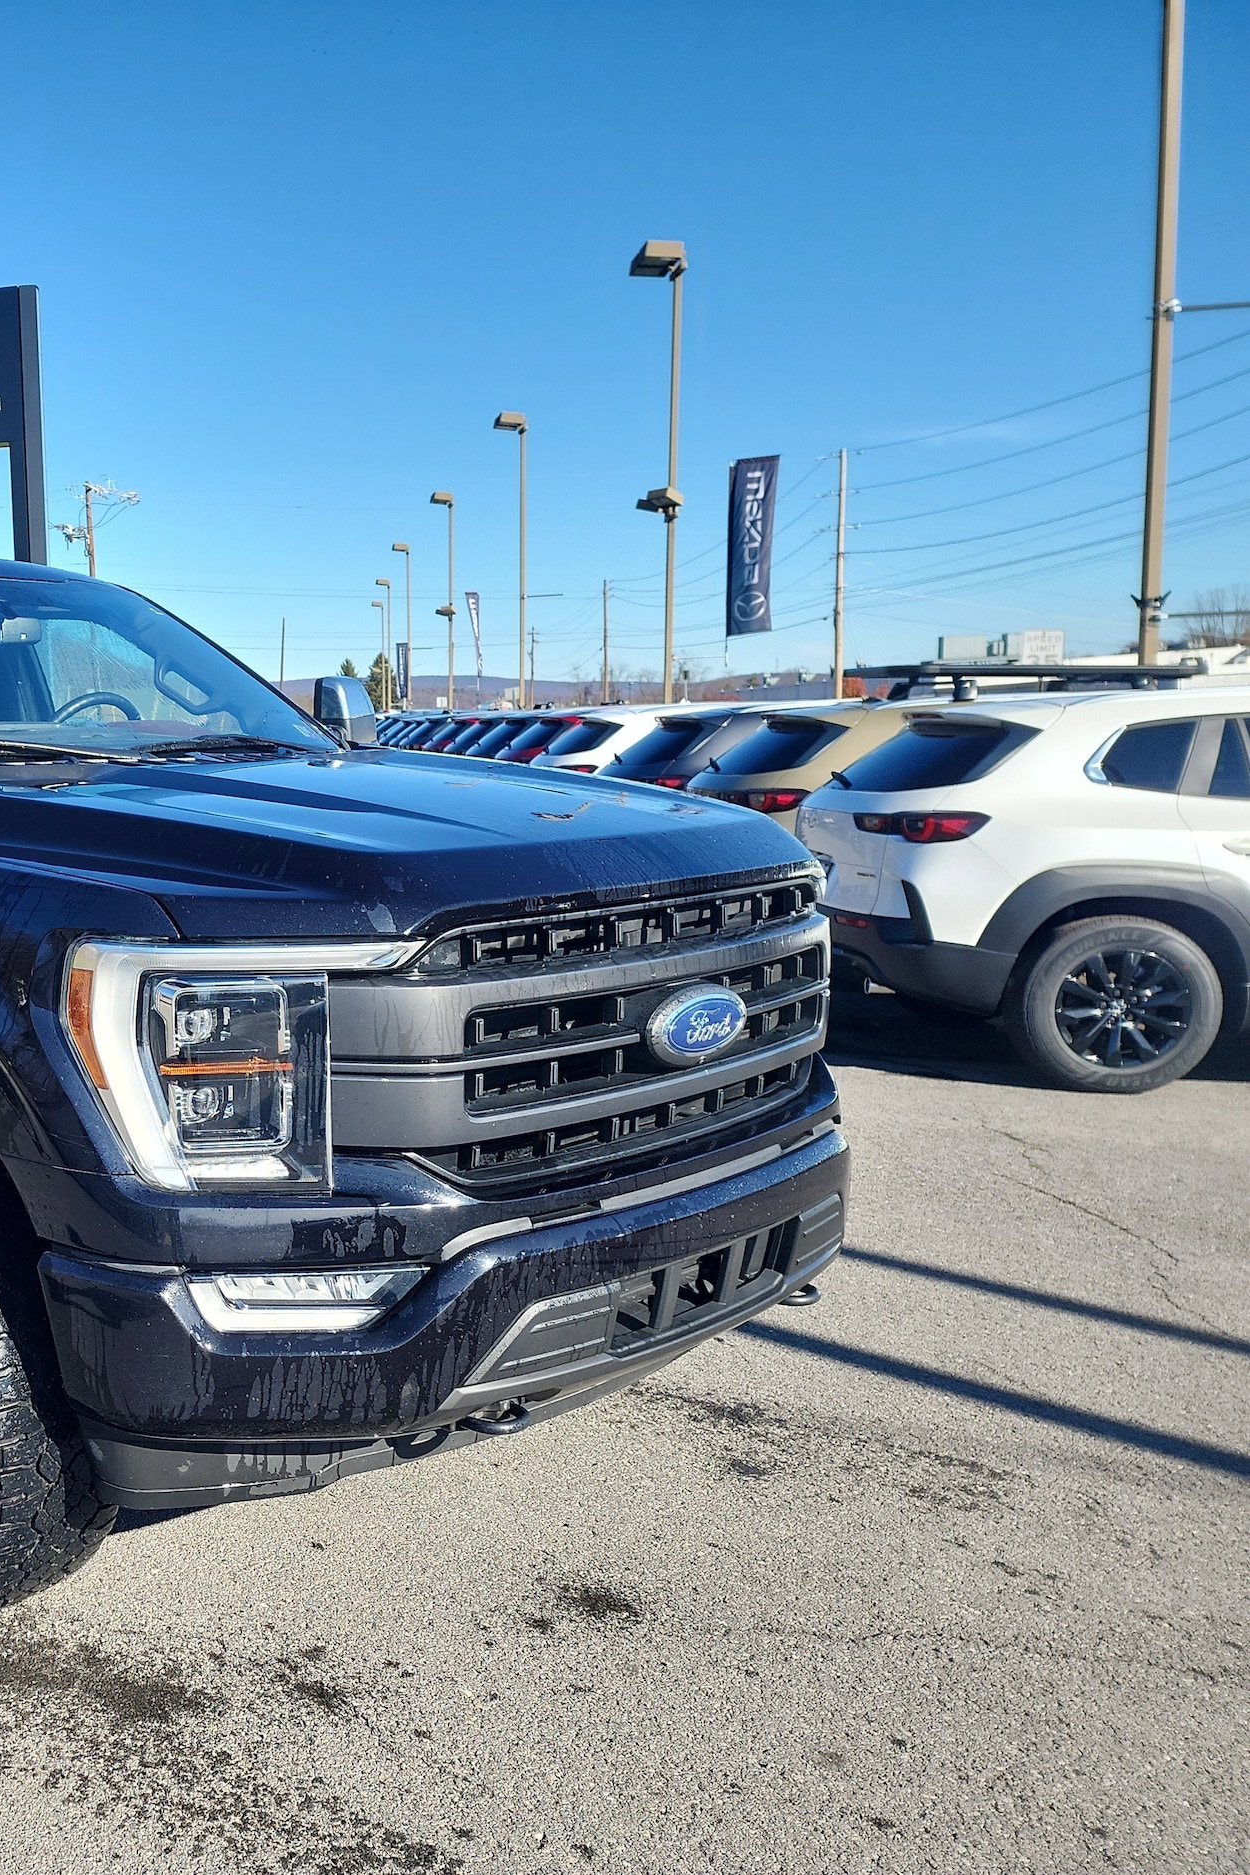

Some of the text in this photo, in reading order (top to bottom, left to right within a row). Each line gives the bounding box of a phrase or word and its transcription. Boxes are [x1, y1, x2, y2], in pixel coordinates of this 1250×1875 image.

[1026, 635, 1061, 643] SPEED
[1030, 644, 1056, 653] LIMIT
[686, 1008, 731, 1045] Ford
